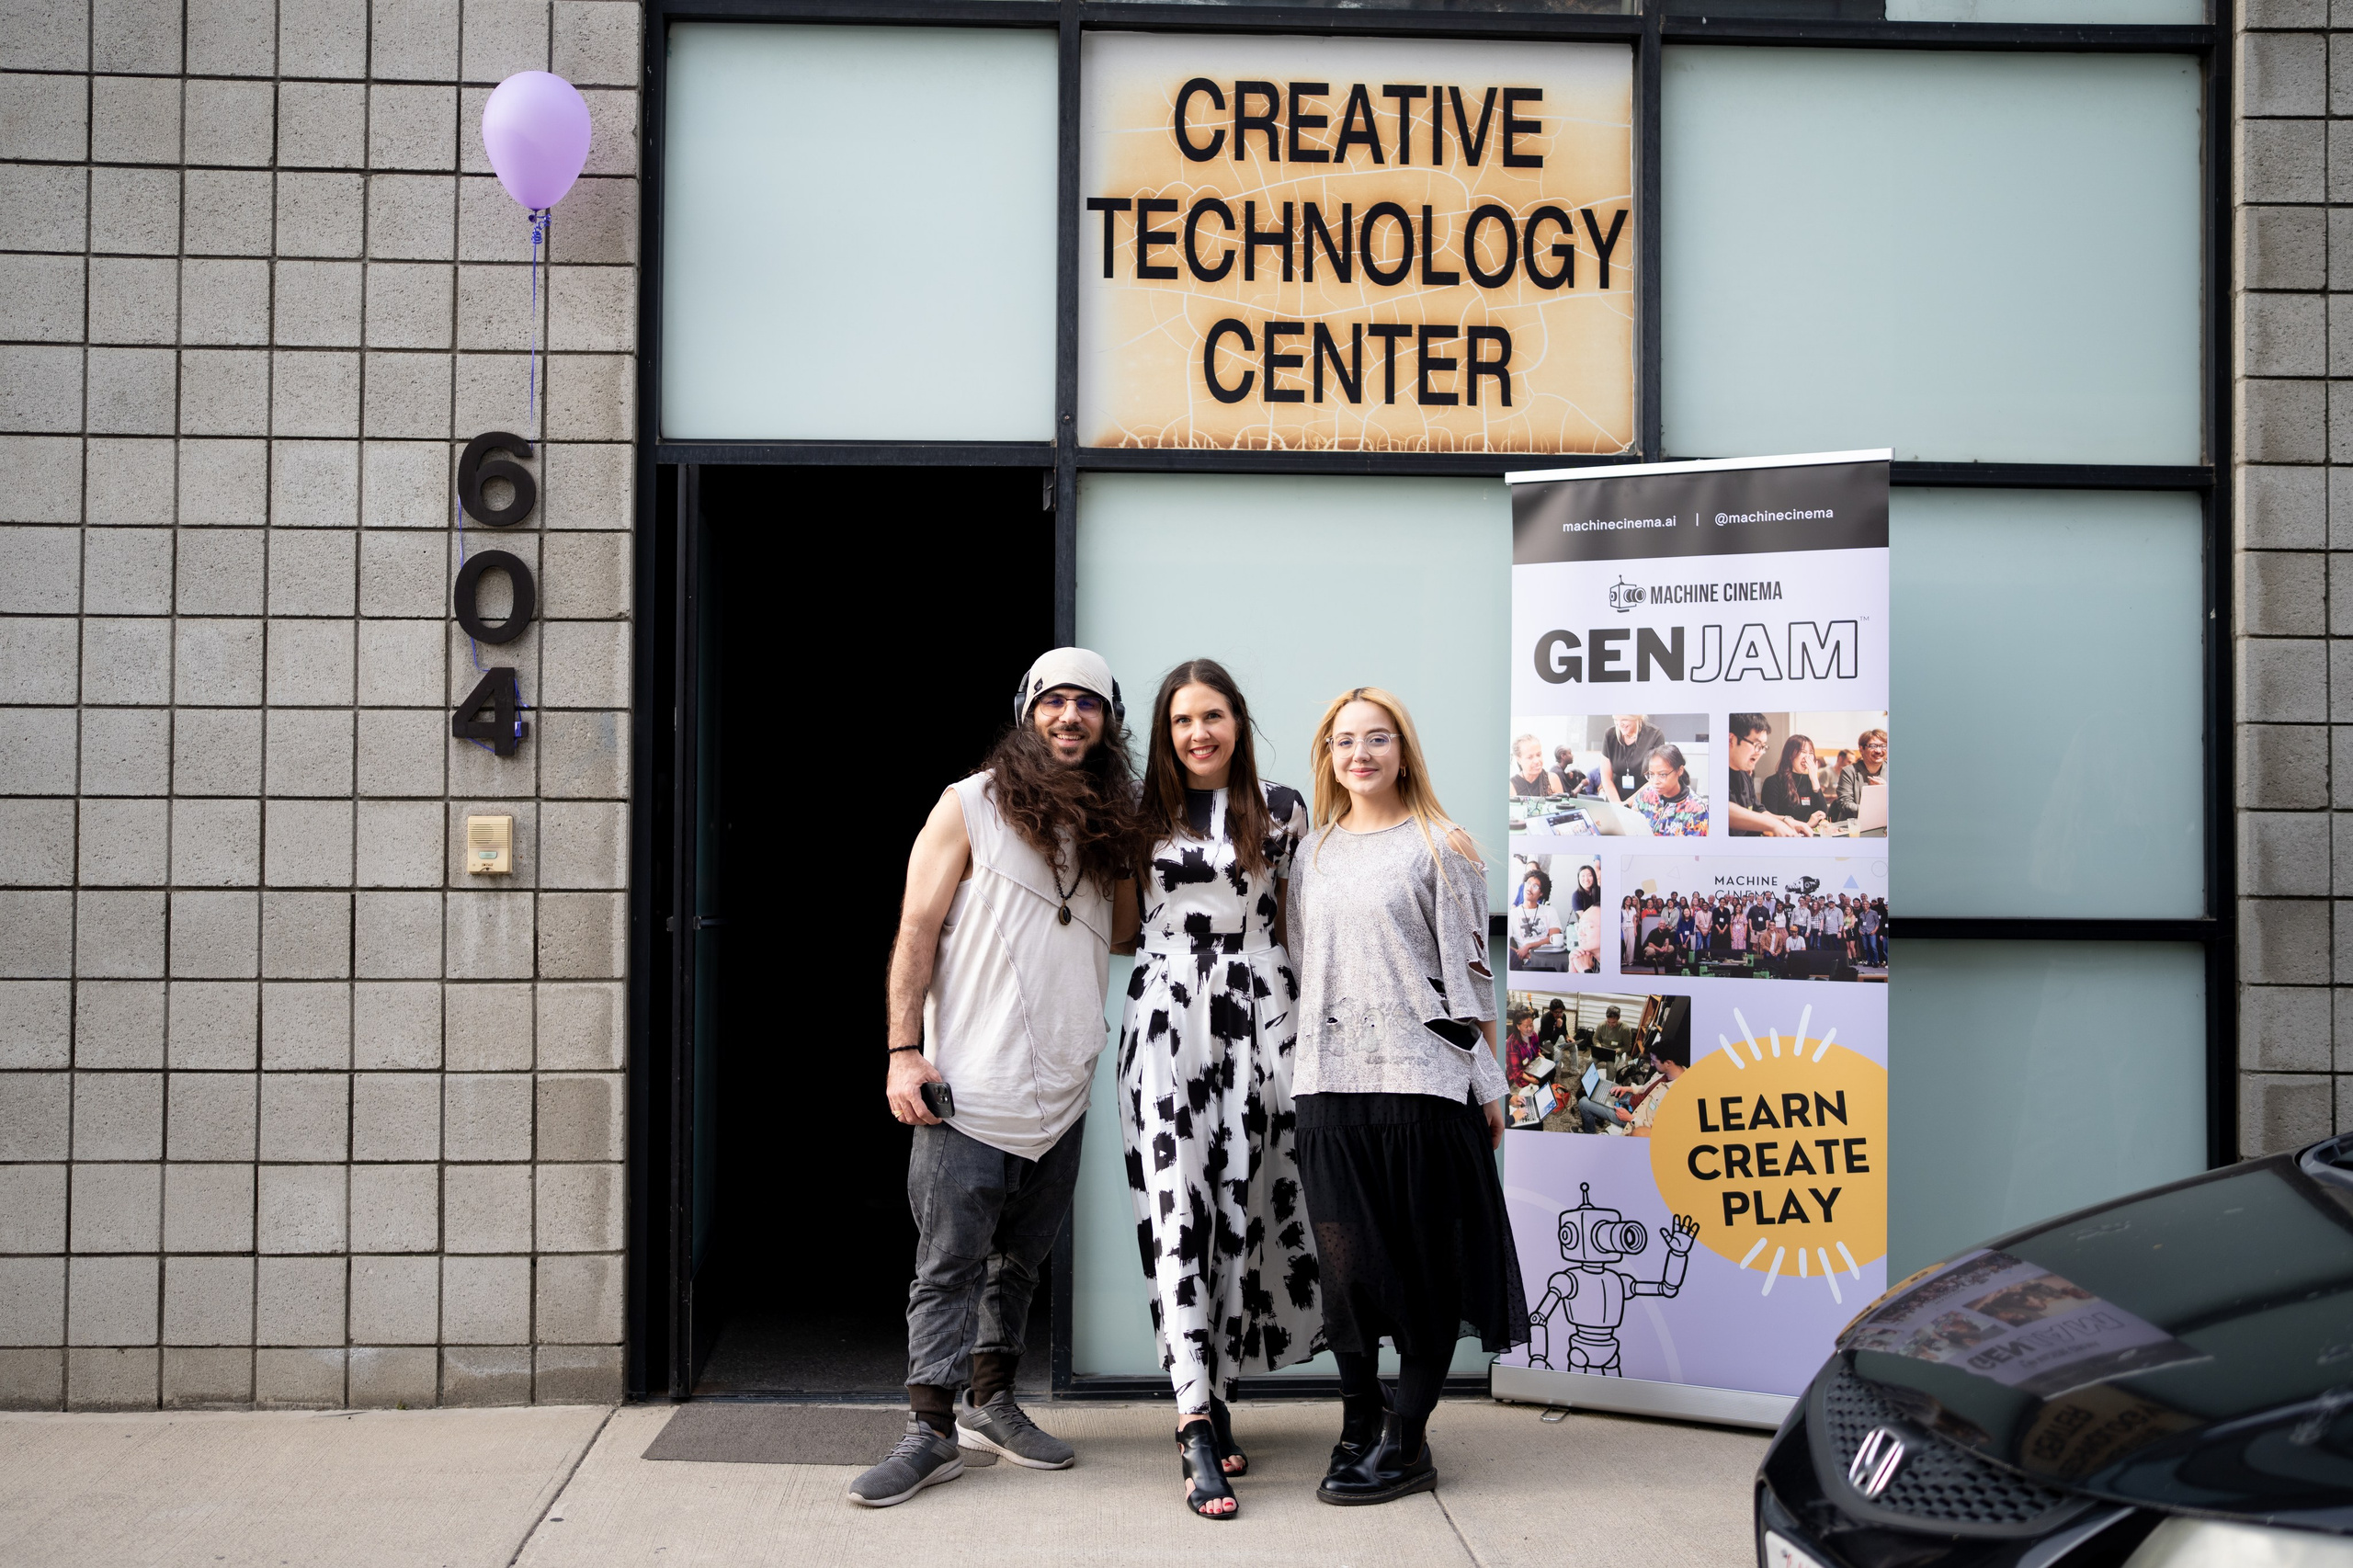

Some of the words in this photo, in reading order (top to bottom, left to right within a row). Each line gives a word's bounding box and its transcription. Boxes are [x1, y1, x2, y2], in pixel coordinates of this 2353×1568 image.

[1175, 77, 1543, 168] CREATIVE
[1087, 197, 1628, 290] TECHNOLOGY
[1204, 318, 1512, 407] CENTER
[1563, 515, 1677, 532] machinecinema.ai
[1714, 508, 1834, 527] @machinecinema
[452, 431, 536, 756] 604
[1651, 584, 1719, 605] MACHINE
[1723, 581, 1783, 602] CINEMA
[1533, 619, 1859, 685] GENJAM
[1714, 875, 1778, 886] MACHINE
[1697, 1090, 1847, 1132] LEARN
[1688, 1138, 1870, 1181] CREATE
[1722, 1187, 1842, 1226] PLAY
